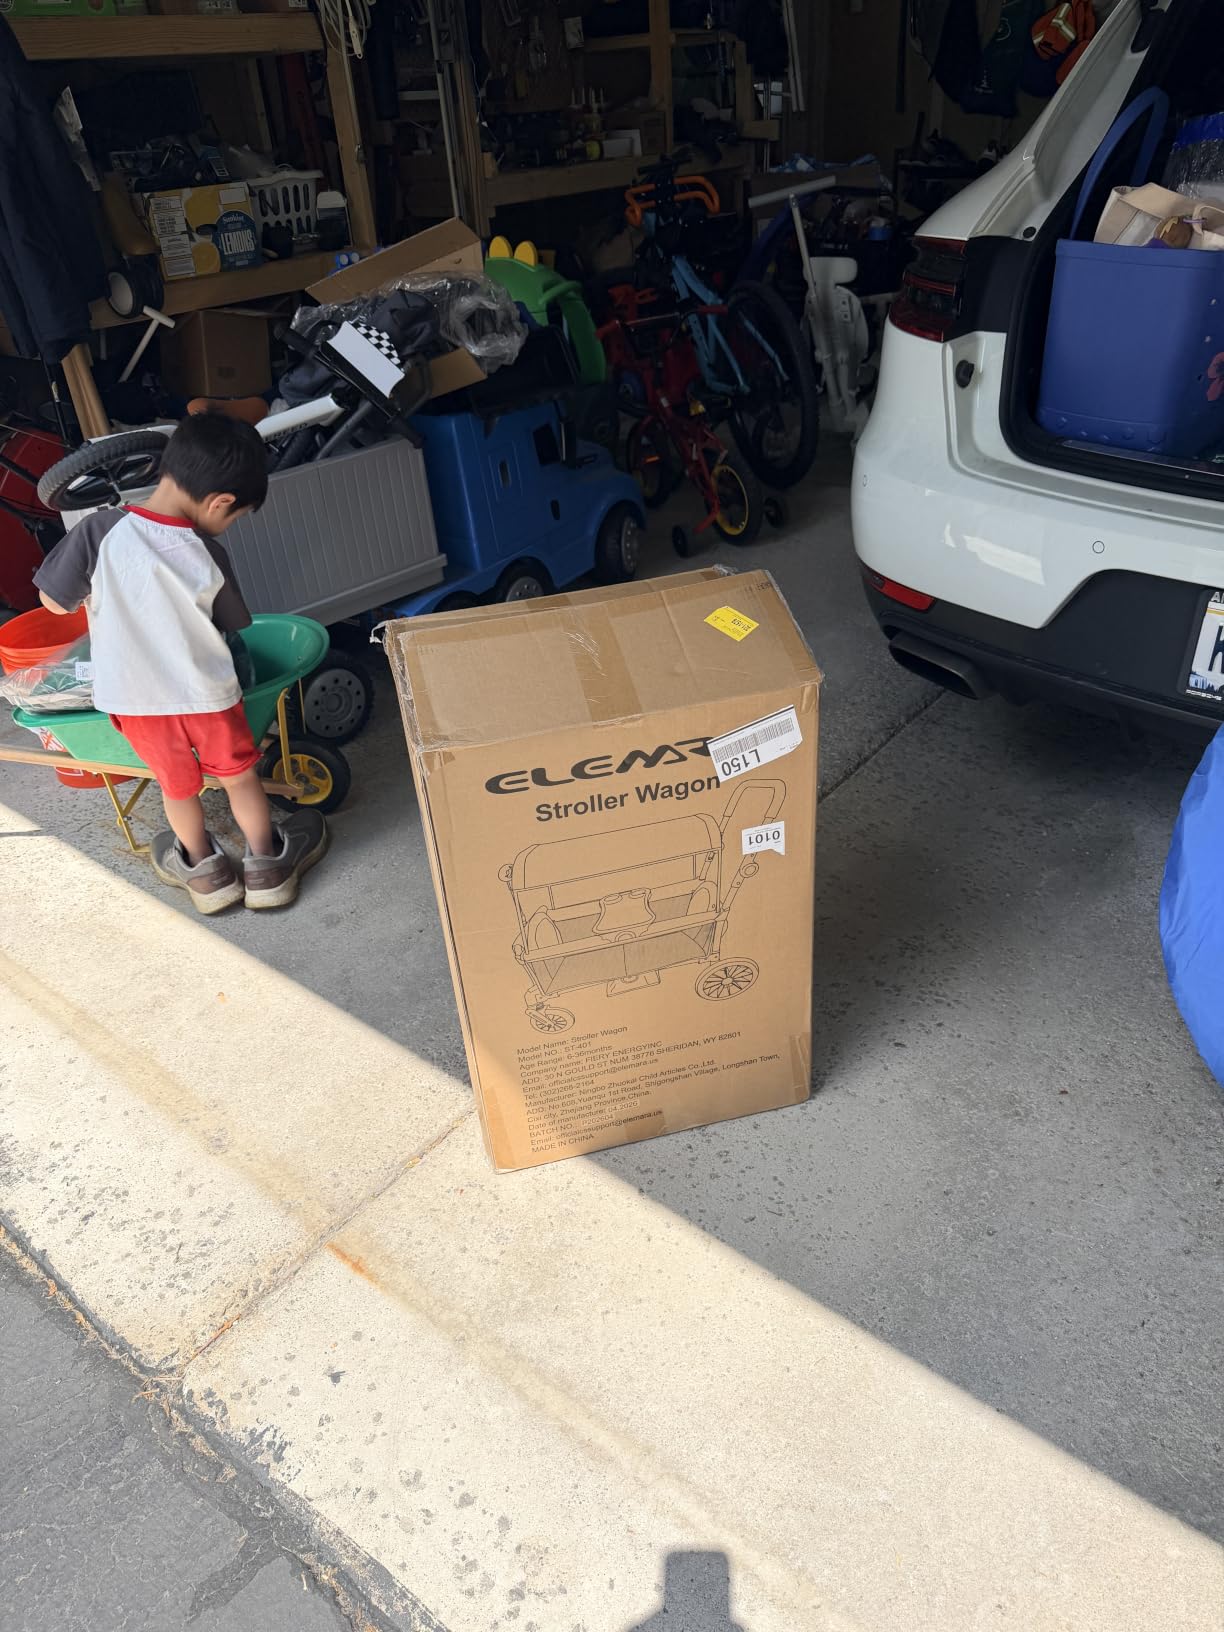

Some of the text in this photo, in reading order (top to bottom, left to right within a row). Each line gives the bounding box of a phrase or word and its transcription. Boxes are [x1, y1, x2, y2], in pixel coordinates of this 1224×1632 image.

[222, 230, 255, 255] LEMONS
[721, 749, 761, 777] L150
[536, 775, 720, 822] Stroller Wagon
[517, 1026, 627, 1055] Model Name: Stroller Wagon
[518, 1053, 542, 1063] Model
[565, 1041, 591, 1052] ST-401
[521, 1040, 662, 1078] Company name: FIERY ENERGYINC
[538, 1056, 564, 1066] Range:
[567, 1045, 612, 1059] 6-36months
[565, 1064, 594, 1075] GOULD
[610, 1056, 628, 1065] NUM
[657, 1040, 701, 1055] SHERIDAN,
[695, 1067, 720, 1077] Village,
[723, 1058, 757, 1070] Longshan
[760, 1054, 780, 1062] Town,
[523, 1084, 547, 1093] Email:
[525, 1094, 577, 1108] Manufacturer:
[580, 1086, 605, 1095] Ningbo
[639, 1072, 658, 1082] Child
[660, 1066, 686, 1076] Articles
[560, 1104, 592, 1116] Zhejiang
[529, 1121, 547, 1131] Date
[530, 1127, 558, 1138] BATCH
[532, 1144, 556, 1153] MADE
[569, 1134, 594, 1144] CHINA
